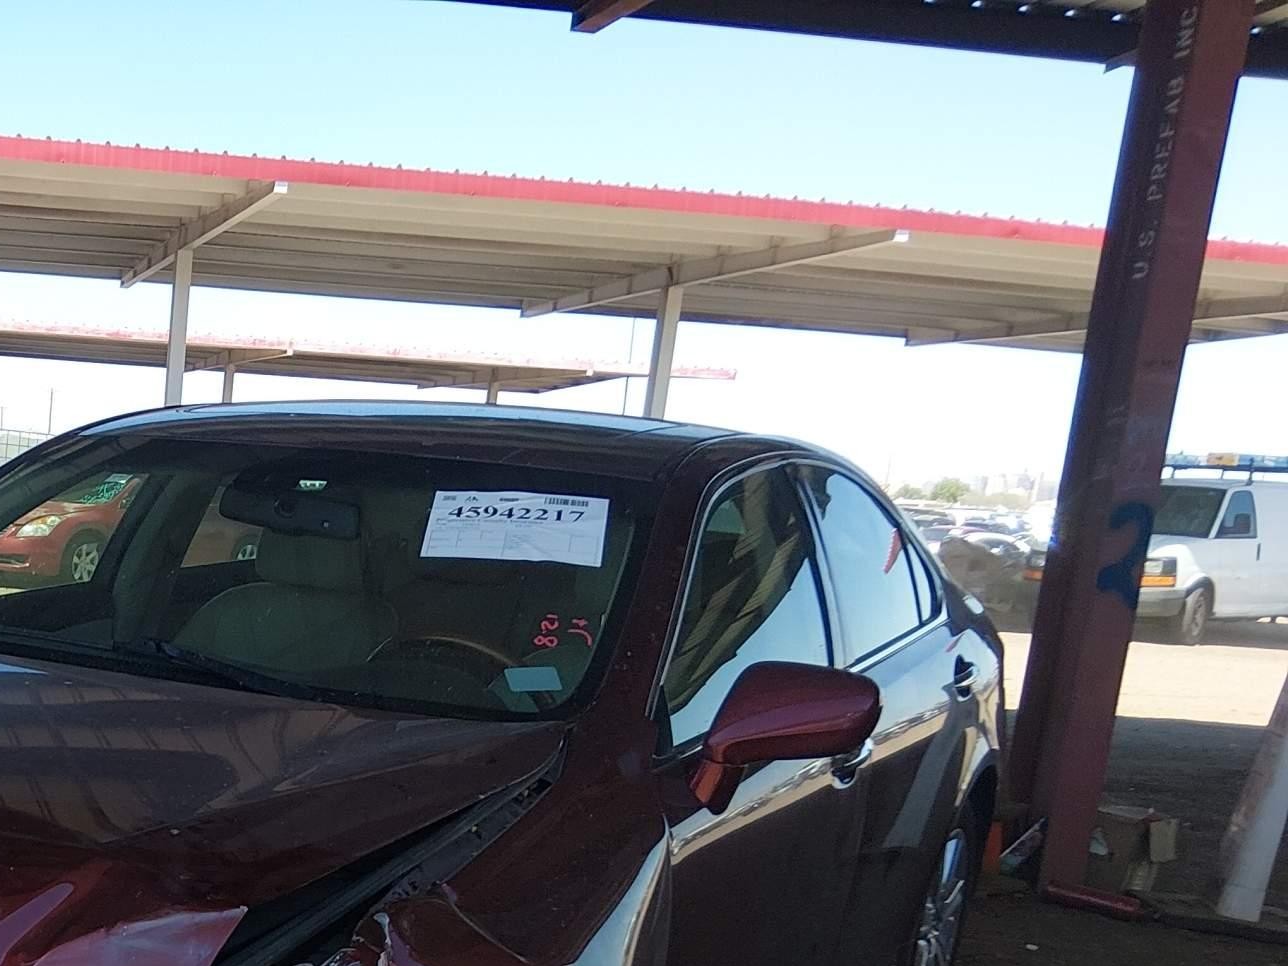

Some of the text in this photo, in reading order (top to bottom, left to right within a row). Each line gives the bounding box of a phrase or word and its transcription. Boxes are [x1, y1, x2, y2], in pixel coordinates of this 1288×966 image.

[1146, 75, 1185, 202] PREFAB
[447, 504, 585, 523] 45942217
[1096, 502, 1154, 609] 2
